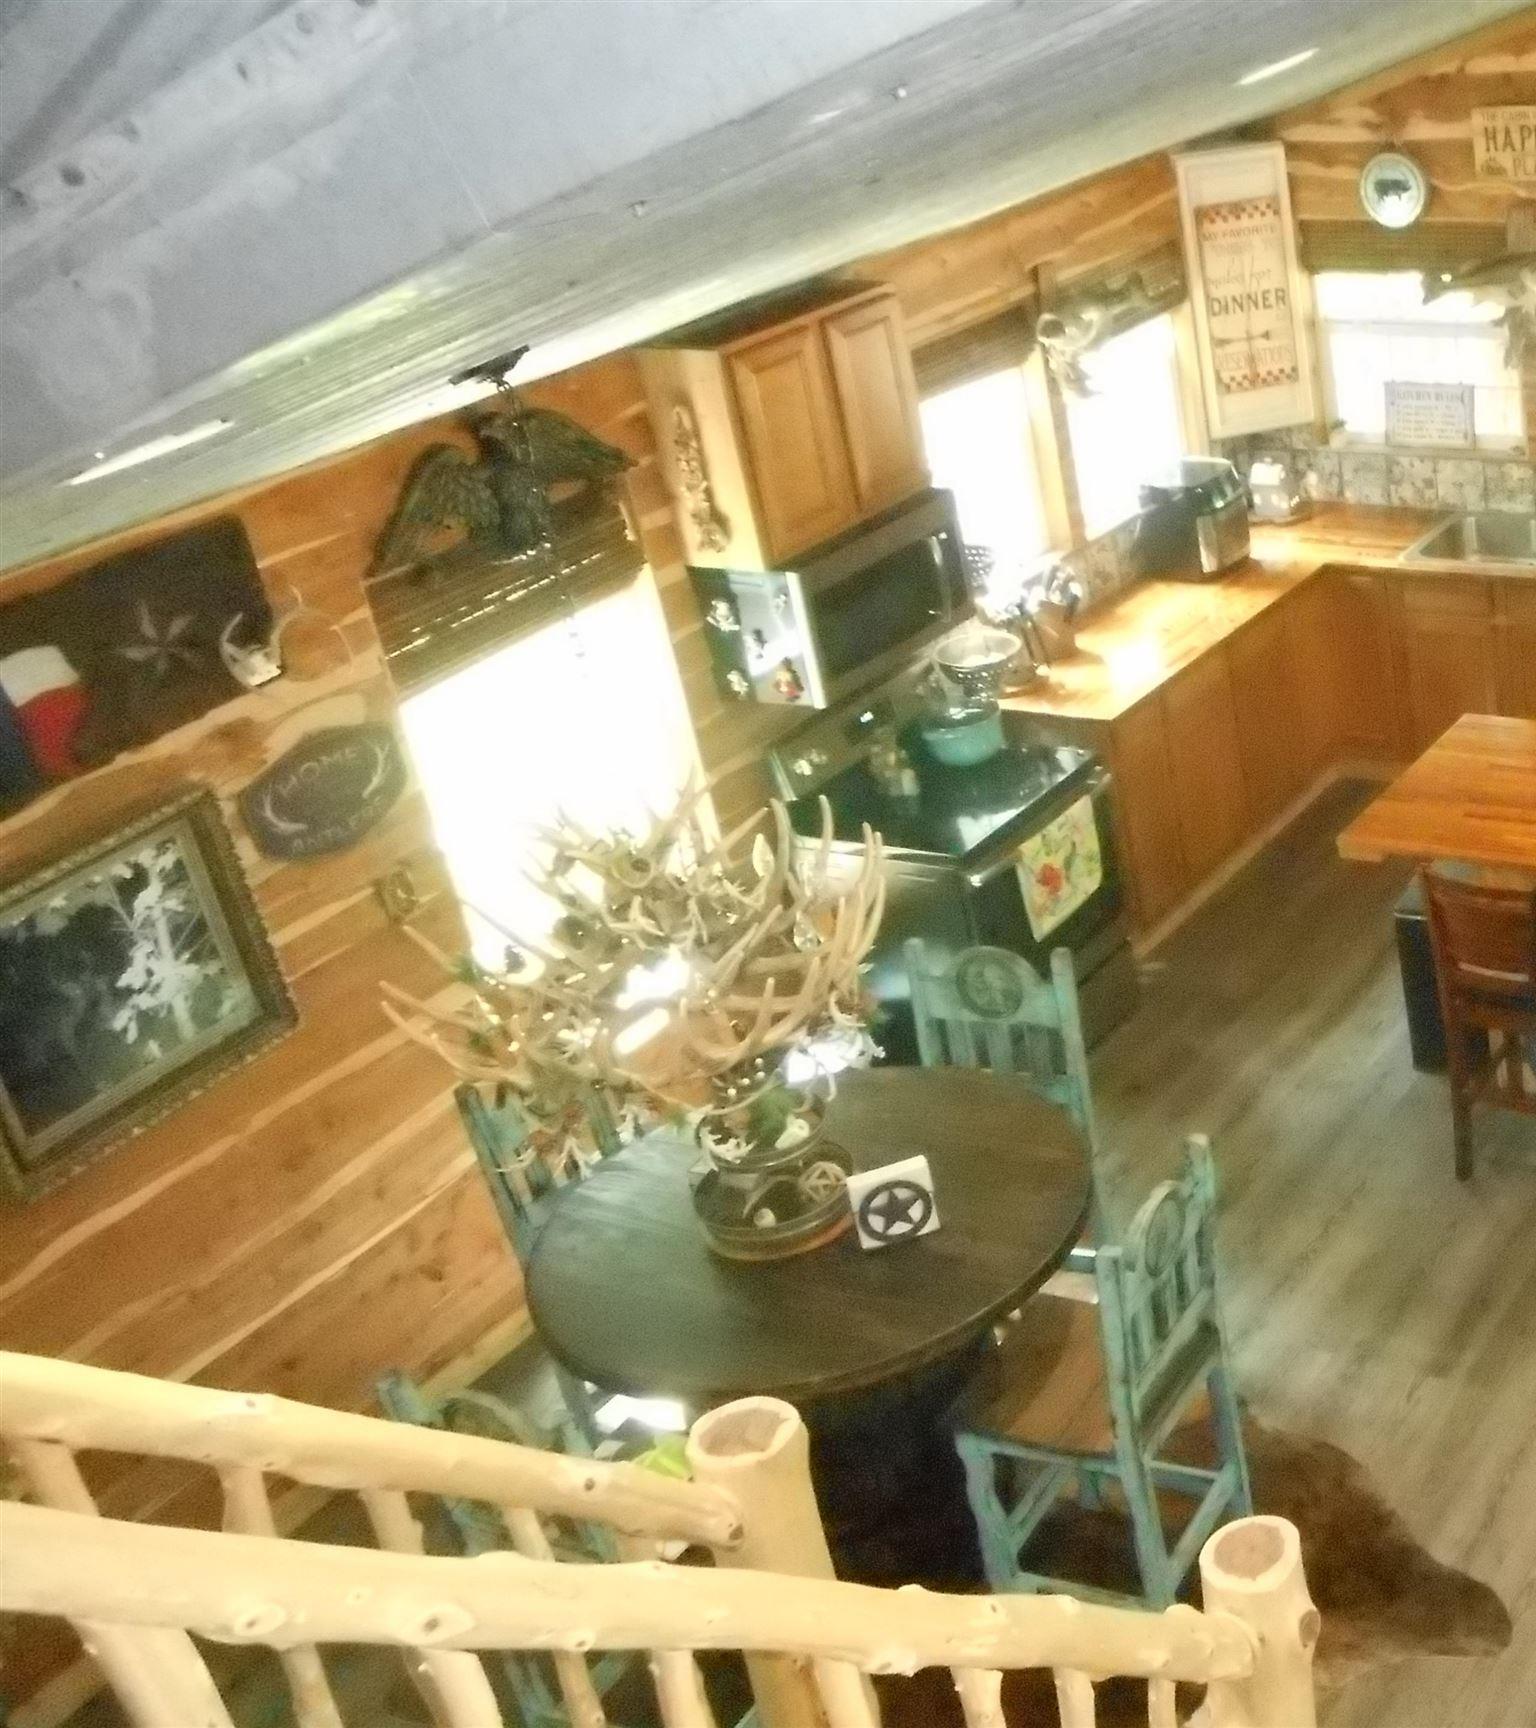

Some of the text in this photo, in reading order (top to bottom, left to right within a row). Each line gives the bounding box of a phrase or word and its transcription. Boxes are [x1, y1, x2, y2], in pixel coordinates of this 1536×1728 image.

[1221, 222, 1276, 241] FAVORITE
[1210, 287, 1286, 317] DINNER
[275, 747, 358, 798] HOME
